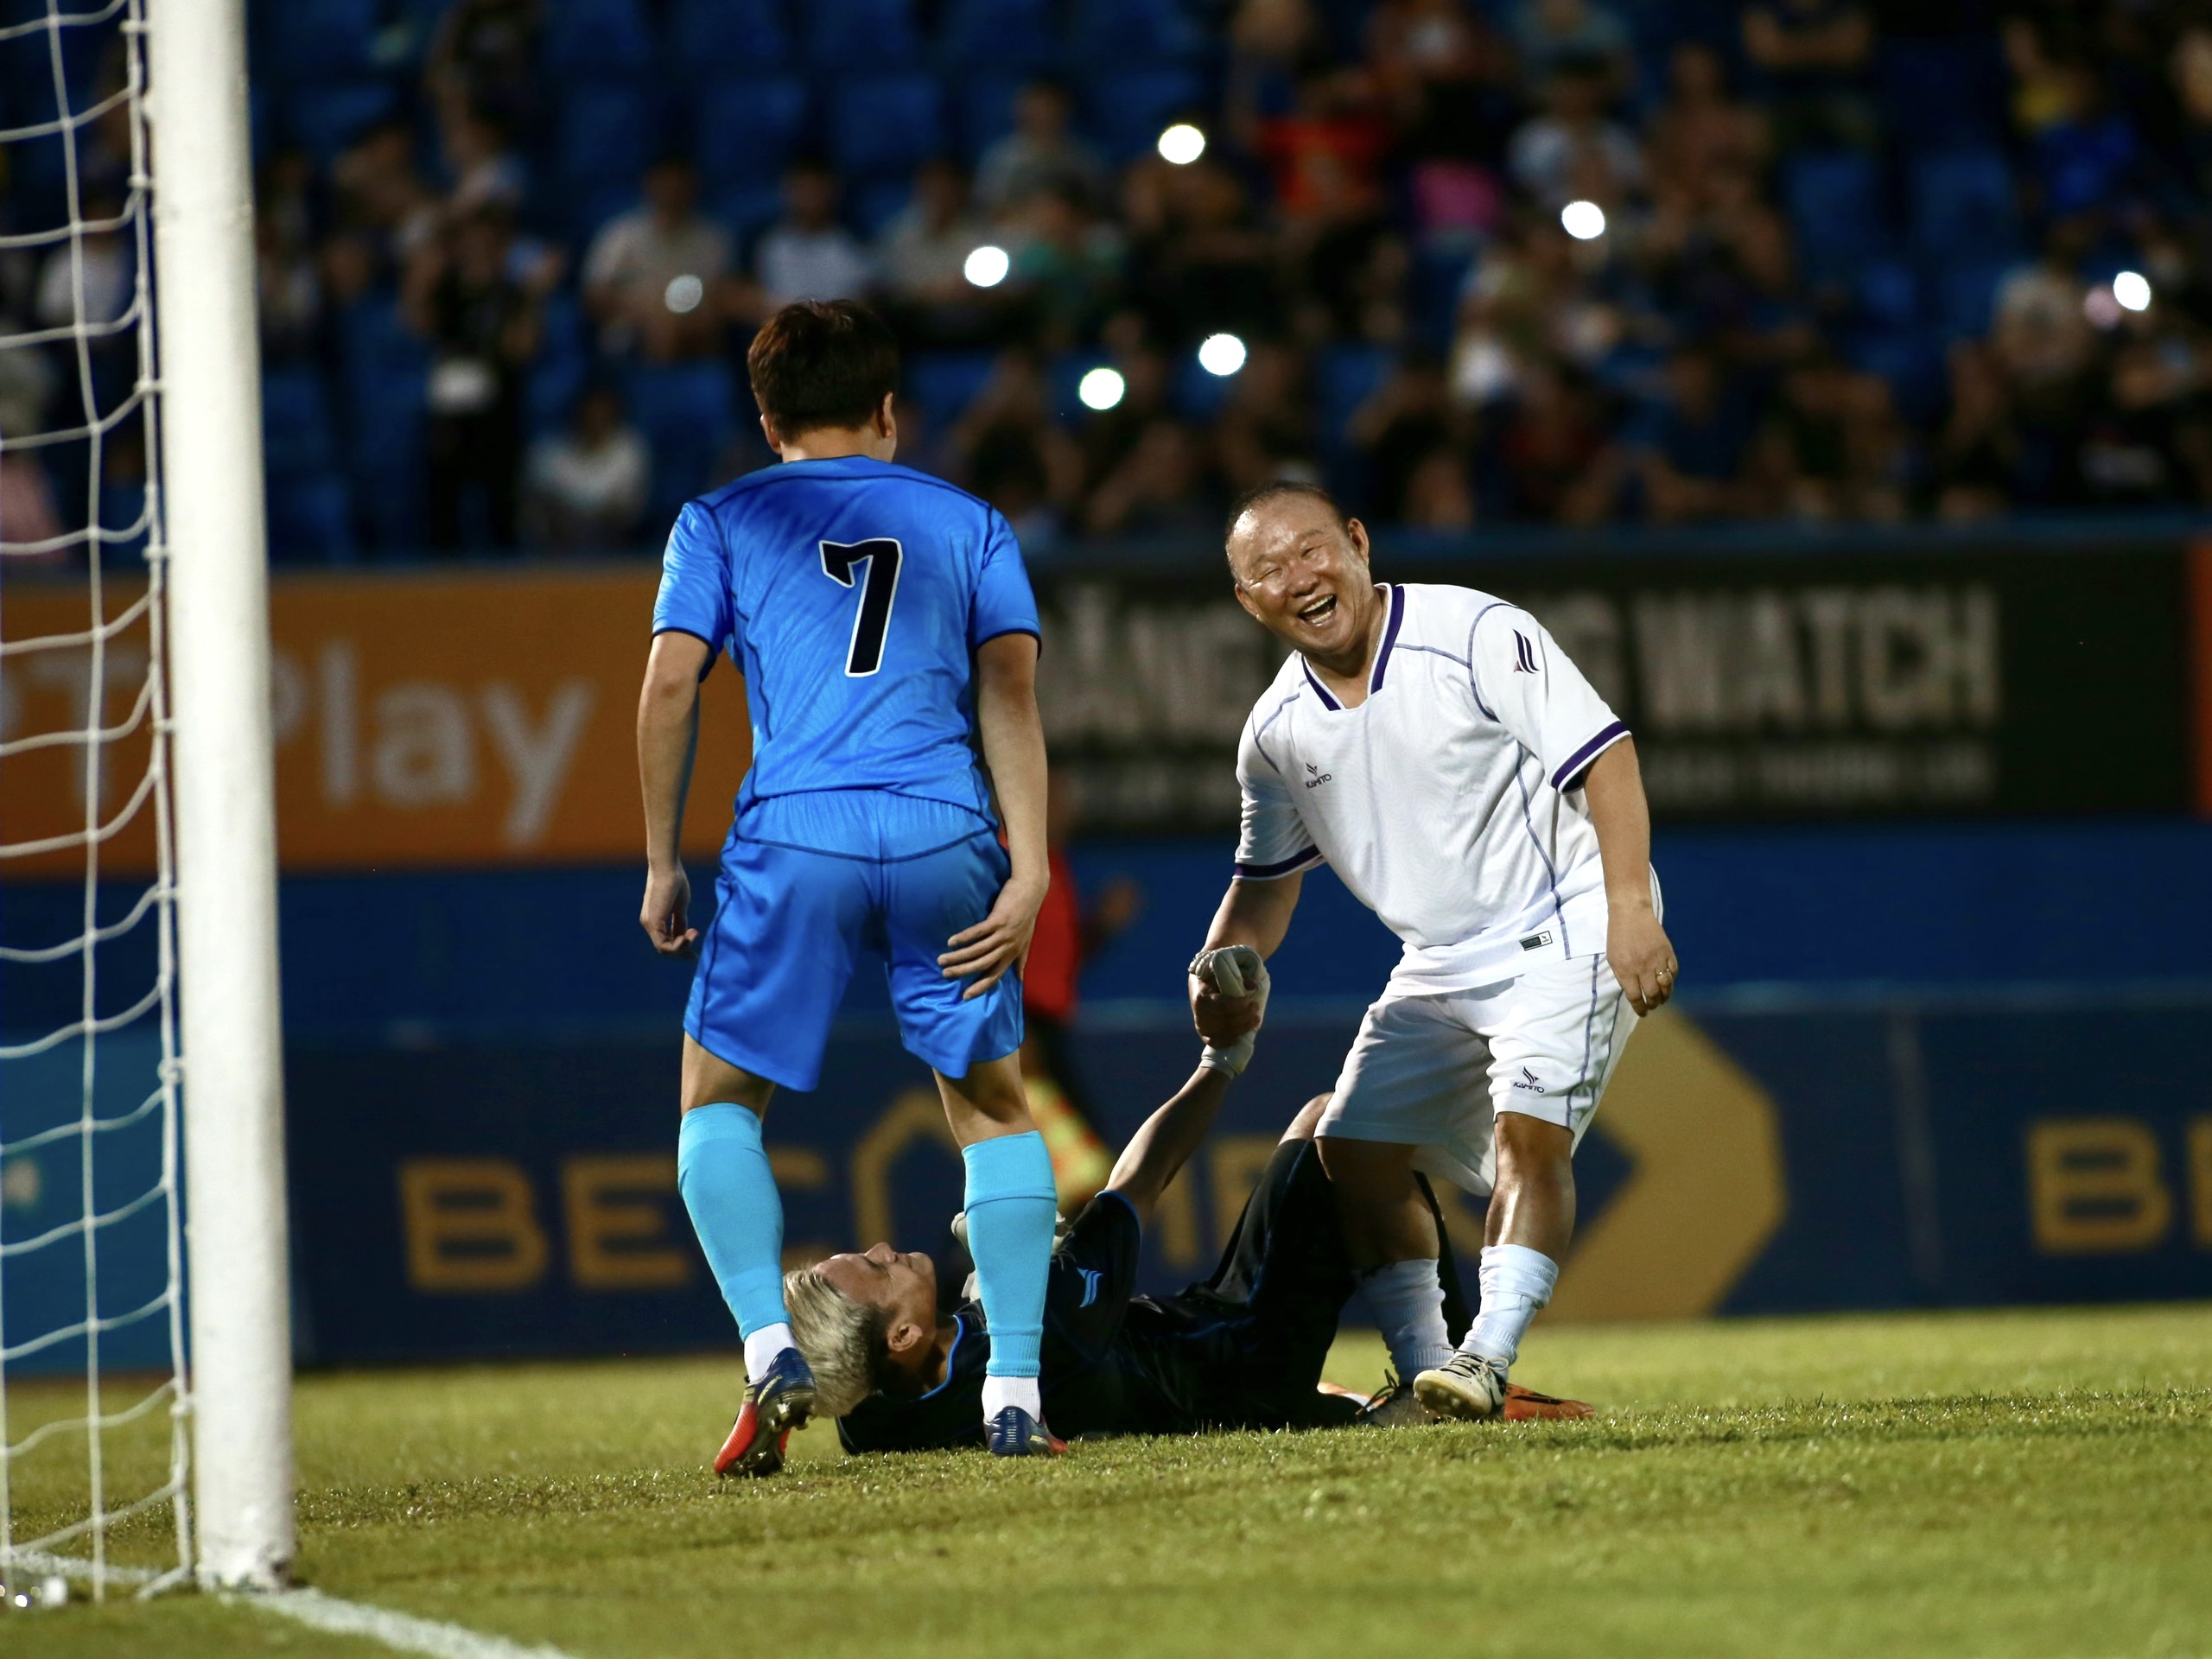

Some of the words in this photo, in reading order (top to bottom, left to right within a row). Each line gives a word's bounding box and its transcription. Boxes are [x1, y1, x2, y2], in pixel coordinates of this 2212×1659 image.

[818, 537, 903, 677] 7
[1637, 589, 1998, 726] WATCH
[1305, 772, 1332, 788] KAMITO
[1513, 1081, 1545, 1093] KAMITO
